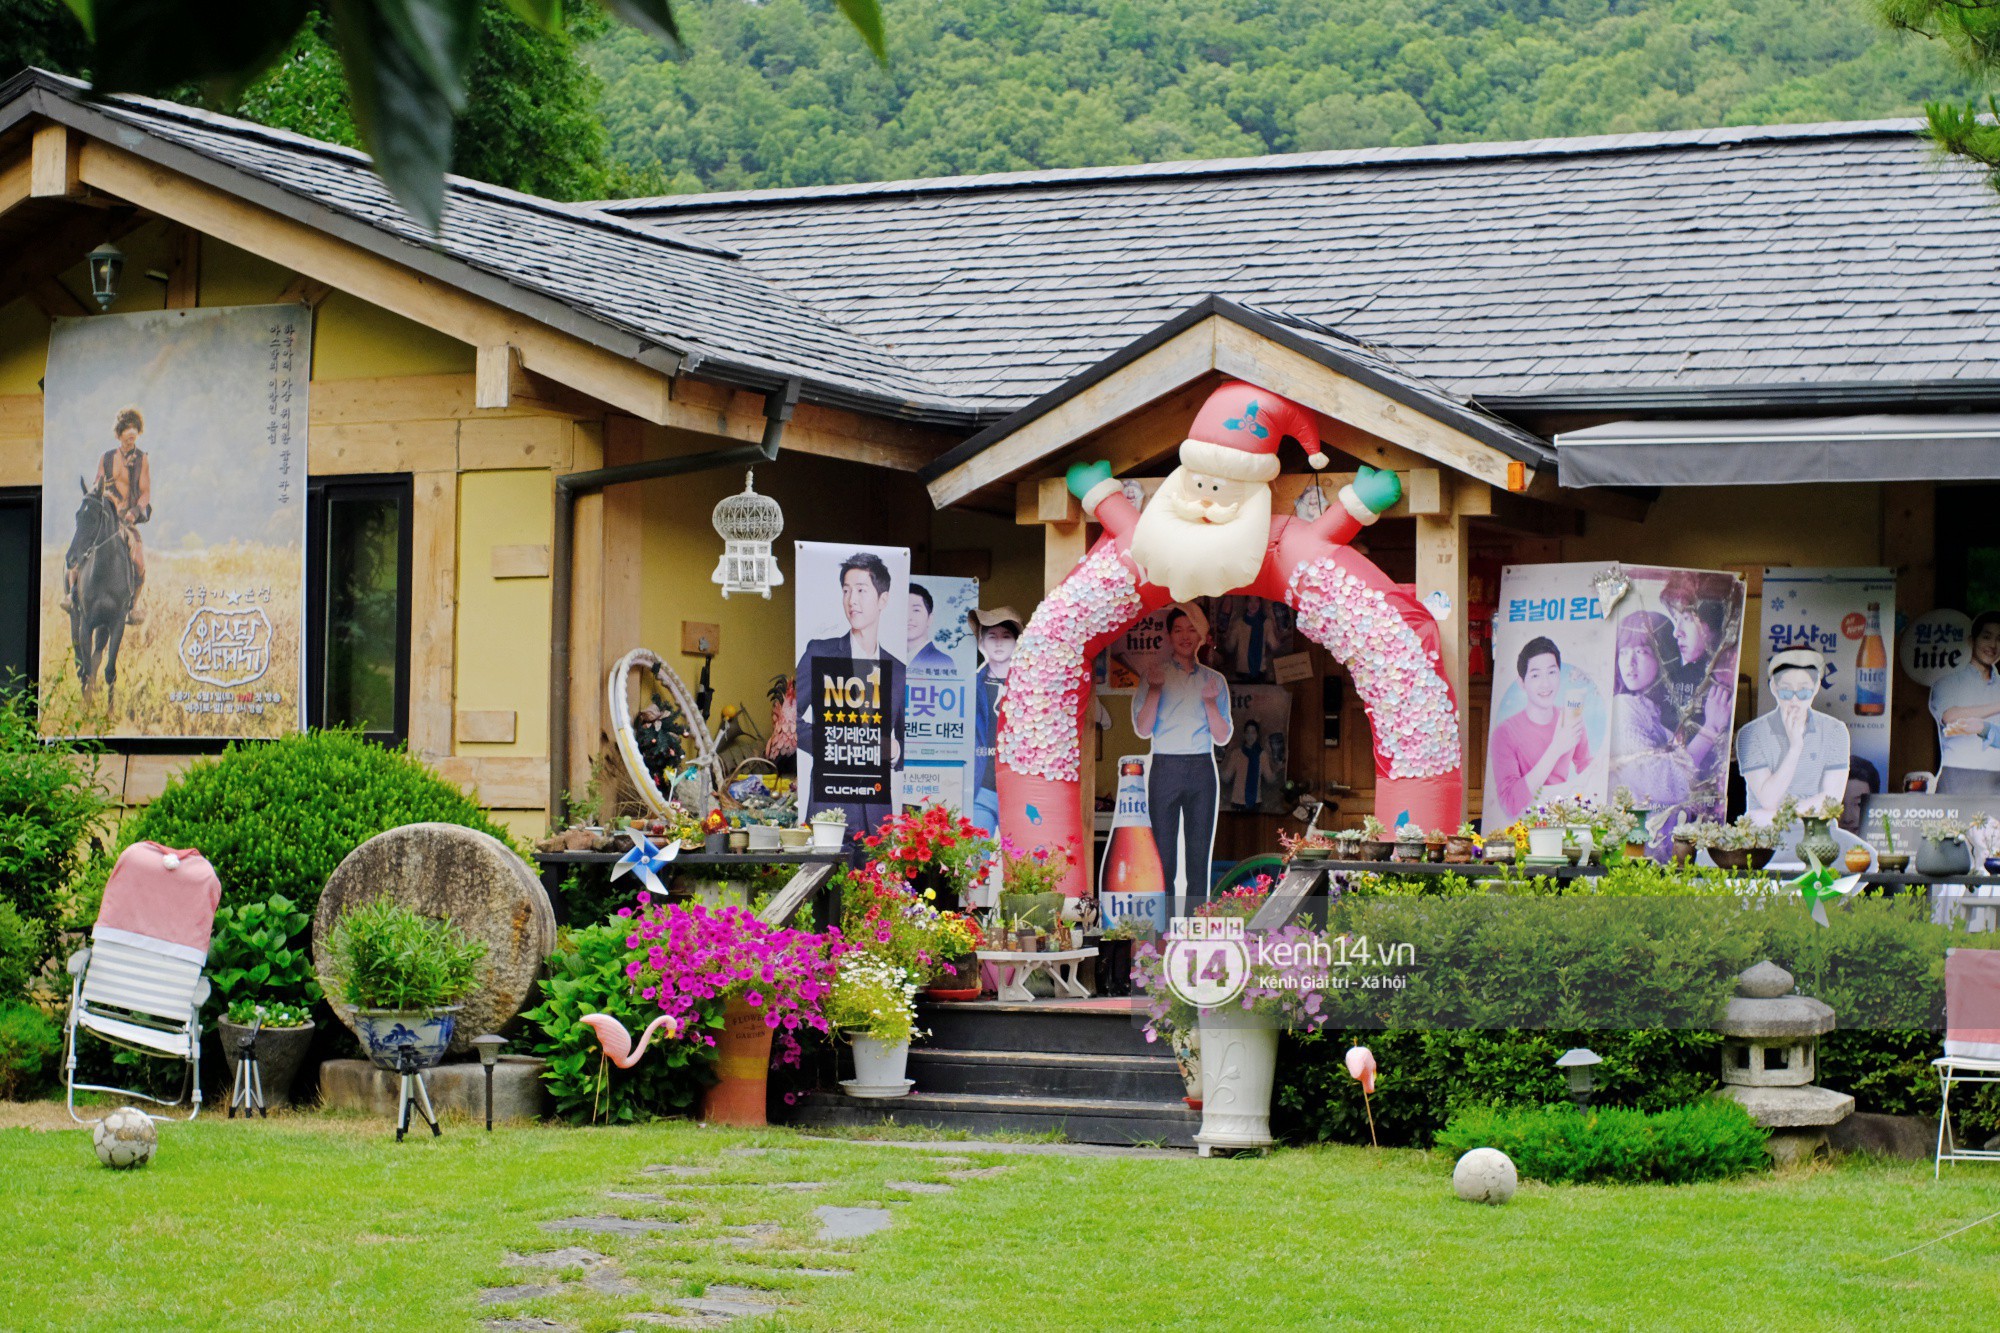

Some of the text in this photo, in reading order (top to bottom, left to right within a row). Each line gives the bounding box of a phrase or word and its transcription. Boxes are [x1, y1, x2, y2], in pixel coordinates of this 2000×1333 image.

[1509, 598, 1566, 622] 봄날이
[1127, 632, 1163, 650] hite
[1915, 623, 1964, 644] 원샷엔
[1913, 645, 1962, 669] hite
[1859, 669, 1885, 682] hite
[823, 665, 881, 709] NO.1
[1231, 691, 1252, 709] ite
[824, 726, 881, 744] 전기레인지
[905, 721, 964, 738] 랜드 대전
[824, 744, 881, 766] 최다판매
[916, 785, 940, 794] 이벤트
[1119, 797, 1147, 814] hite
[1868, 808, 1959, 818] SONG JOONG KI
[1111, 894, 1156, 917] hite
[733, 1014, 763, 1025] FLOWE
